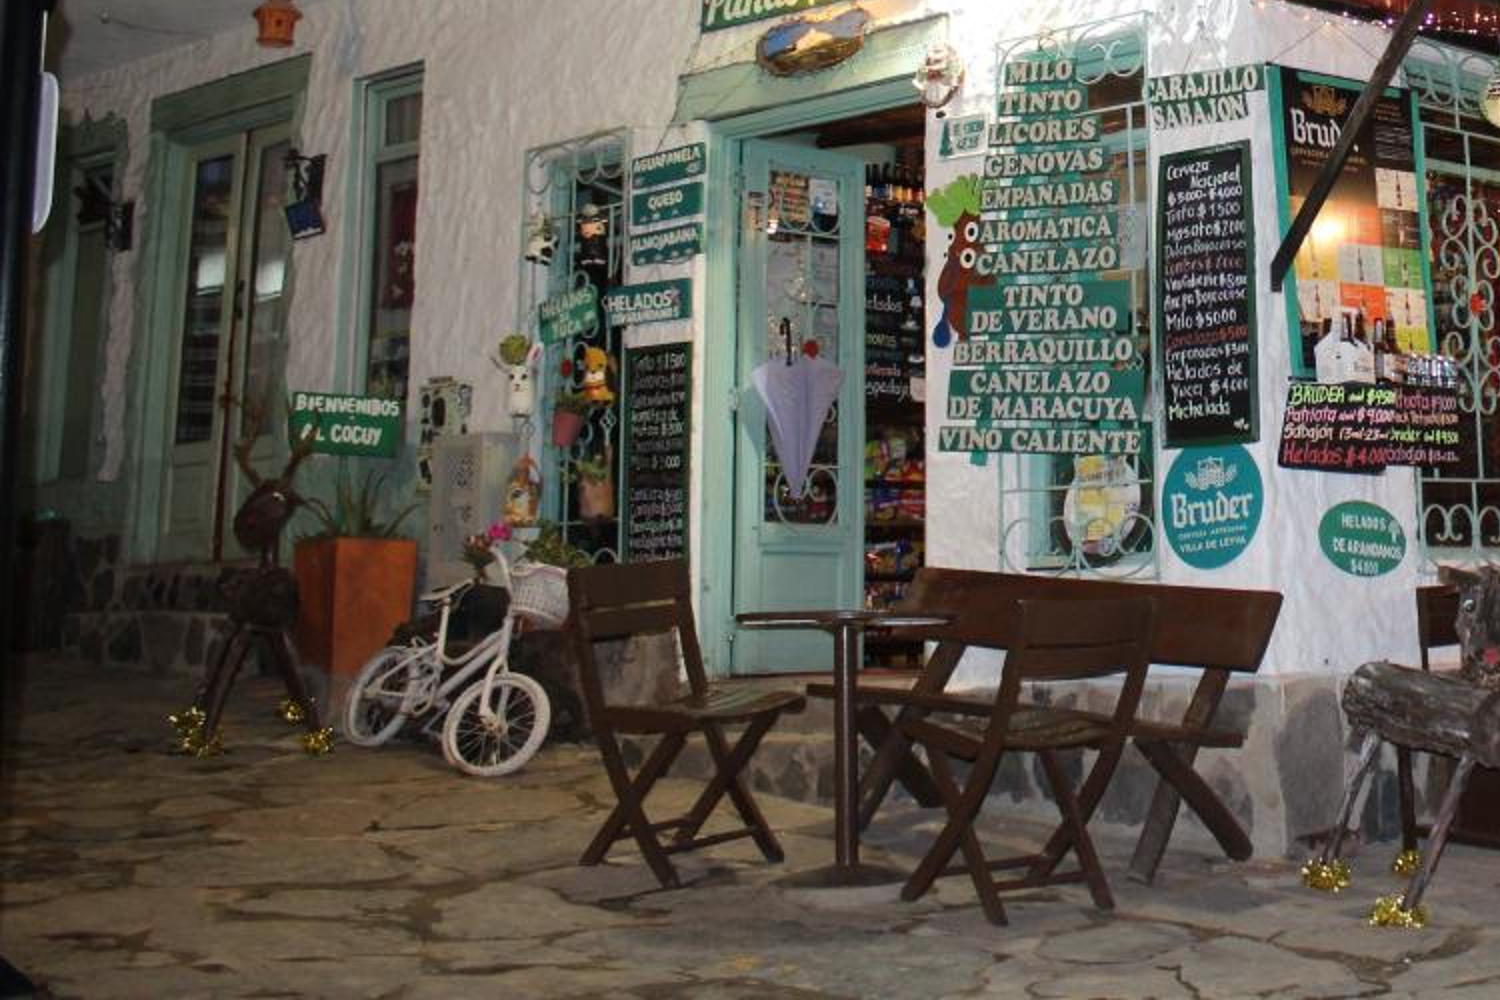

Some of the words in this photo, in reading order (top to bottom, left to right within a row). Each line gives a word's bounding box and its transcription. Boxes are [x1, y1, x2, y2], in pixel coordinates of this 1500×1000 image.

[1007, 60, 1072, 83] MILO
[1142, 67, 1257, 101] CARAJILLO
[1002, 89, 1082, 116] TINTO
[1151, 94, 1246, 130] SABAJON
[989, 118, 1097, 146] LICORES
[985, 148, 1104, 177] GENOVAS
[1167, 161, 1209, 180] Cerveza
[1190, 163, 1240, 189] Nacional
[647, 189, 683, 210] QUESO
[981, 181, 1113, 209] EMPANADAS
[979, 215, 1113, 243] AROMATICA
[976, 247, 1116, 276] CANELAZO
[609, 289, 673, 313] HELADOS
[1003, 284, 1083, 308] TINTO
[970, 312, 1003, 333] DE
[1010, 306, 1117, 332] VERANO
[1165, 311, 1193, 331] Milo
[954, 338, 1133, 363] BERRAQUILLO
[1166, 361, 1221, 380] Helados
[1226, 359, 1243, 375] de
[970, 371, 1110, 394] CANELAZO
[295, 393, 400, 417] BIENVENIDOS
[950, 397, 982, 419] DE
[992, 395, 1138, 420] MARACUYA
[329, 423, 383, 447] COCUY
[940, 429, 1002, 450] VINO
[1011, 430, 1141, 453] CALIENTE
[1170, 490, 1254, 529] Bruder
[1341, 511, 1387, 533] HELADOS
